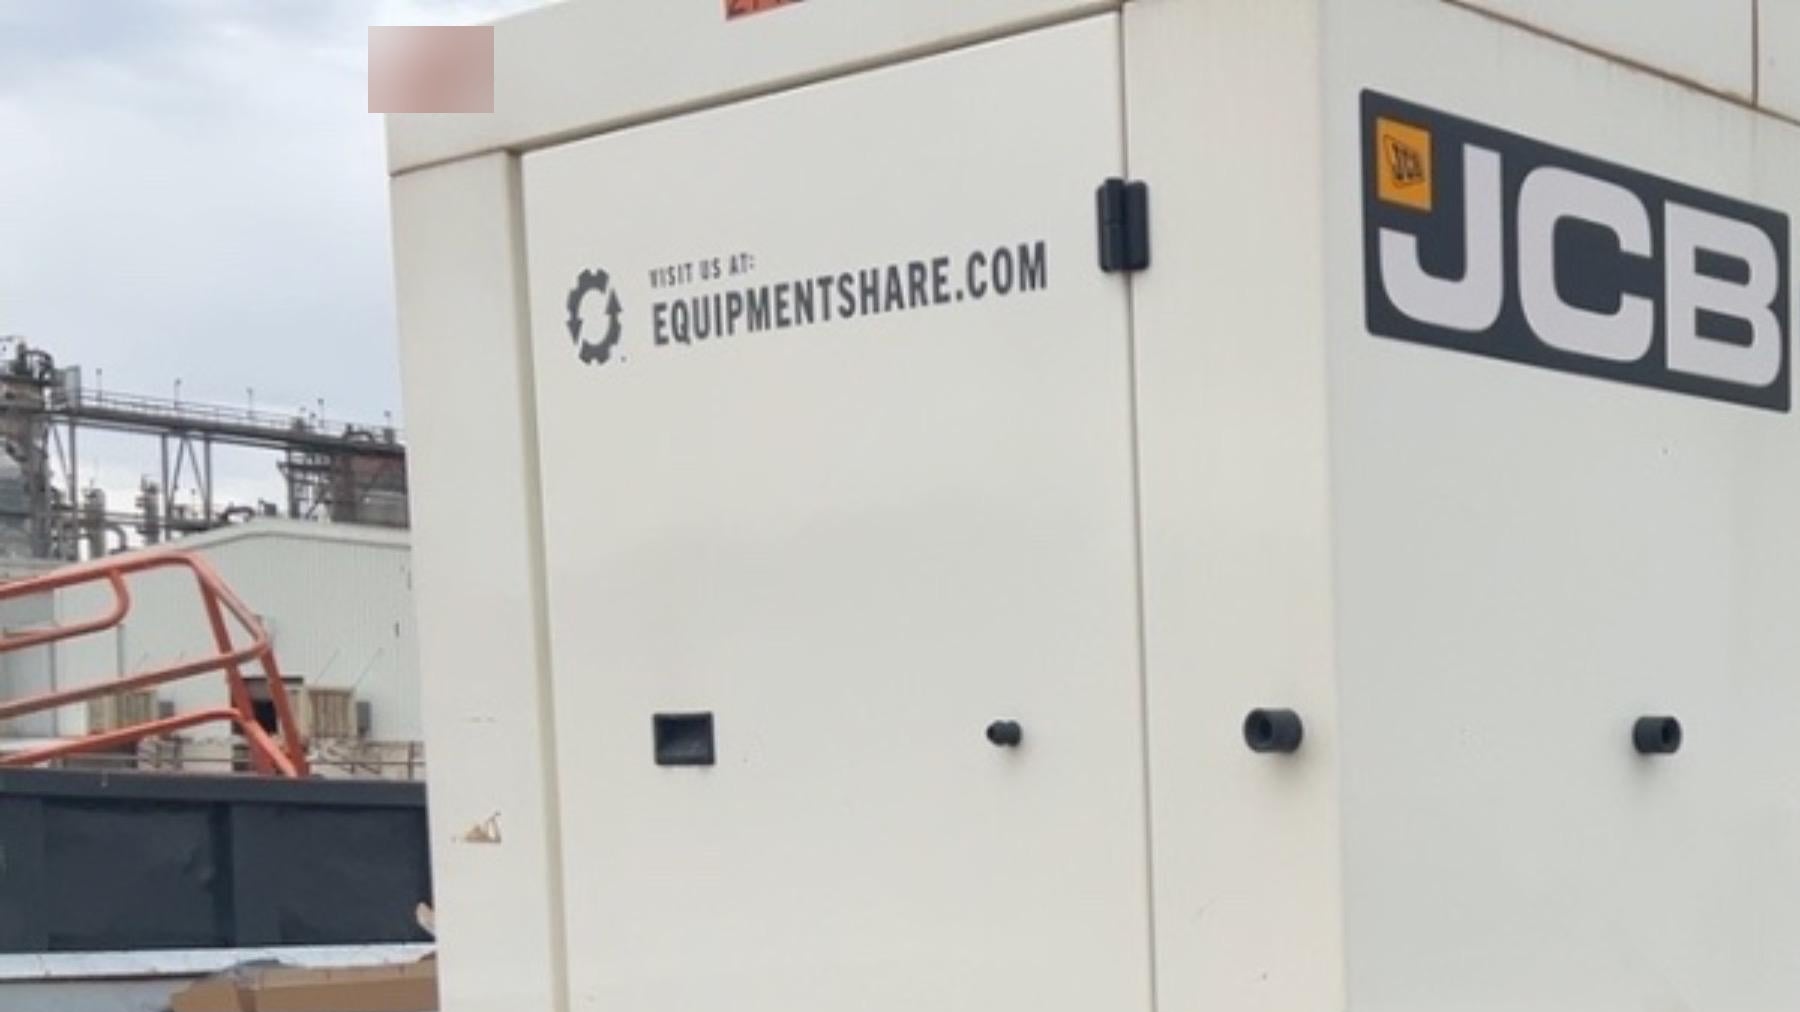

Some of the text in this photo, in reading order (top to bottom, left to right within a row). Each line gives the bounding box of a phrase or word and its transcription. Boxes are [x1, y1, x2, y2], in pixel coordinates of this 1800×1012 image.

[650, 252, 755, 288] VISIT US AT:
[652, 240, 1048, 347] EQUIPMENTSHARE.COM
[1379, 144, 1782, 387] JCB
